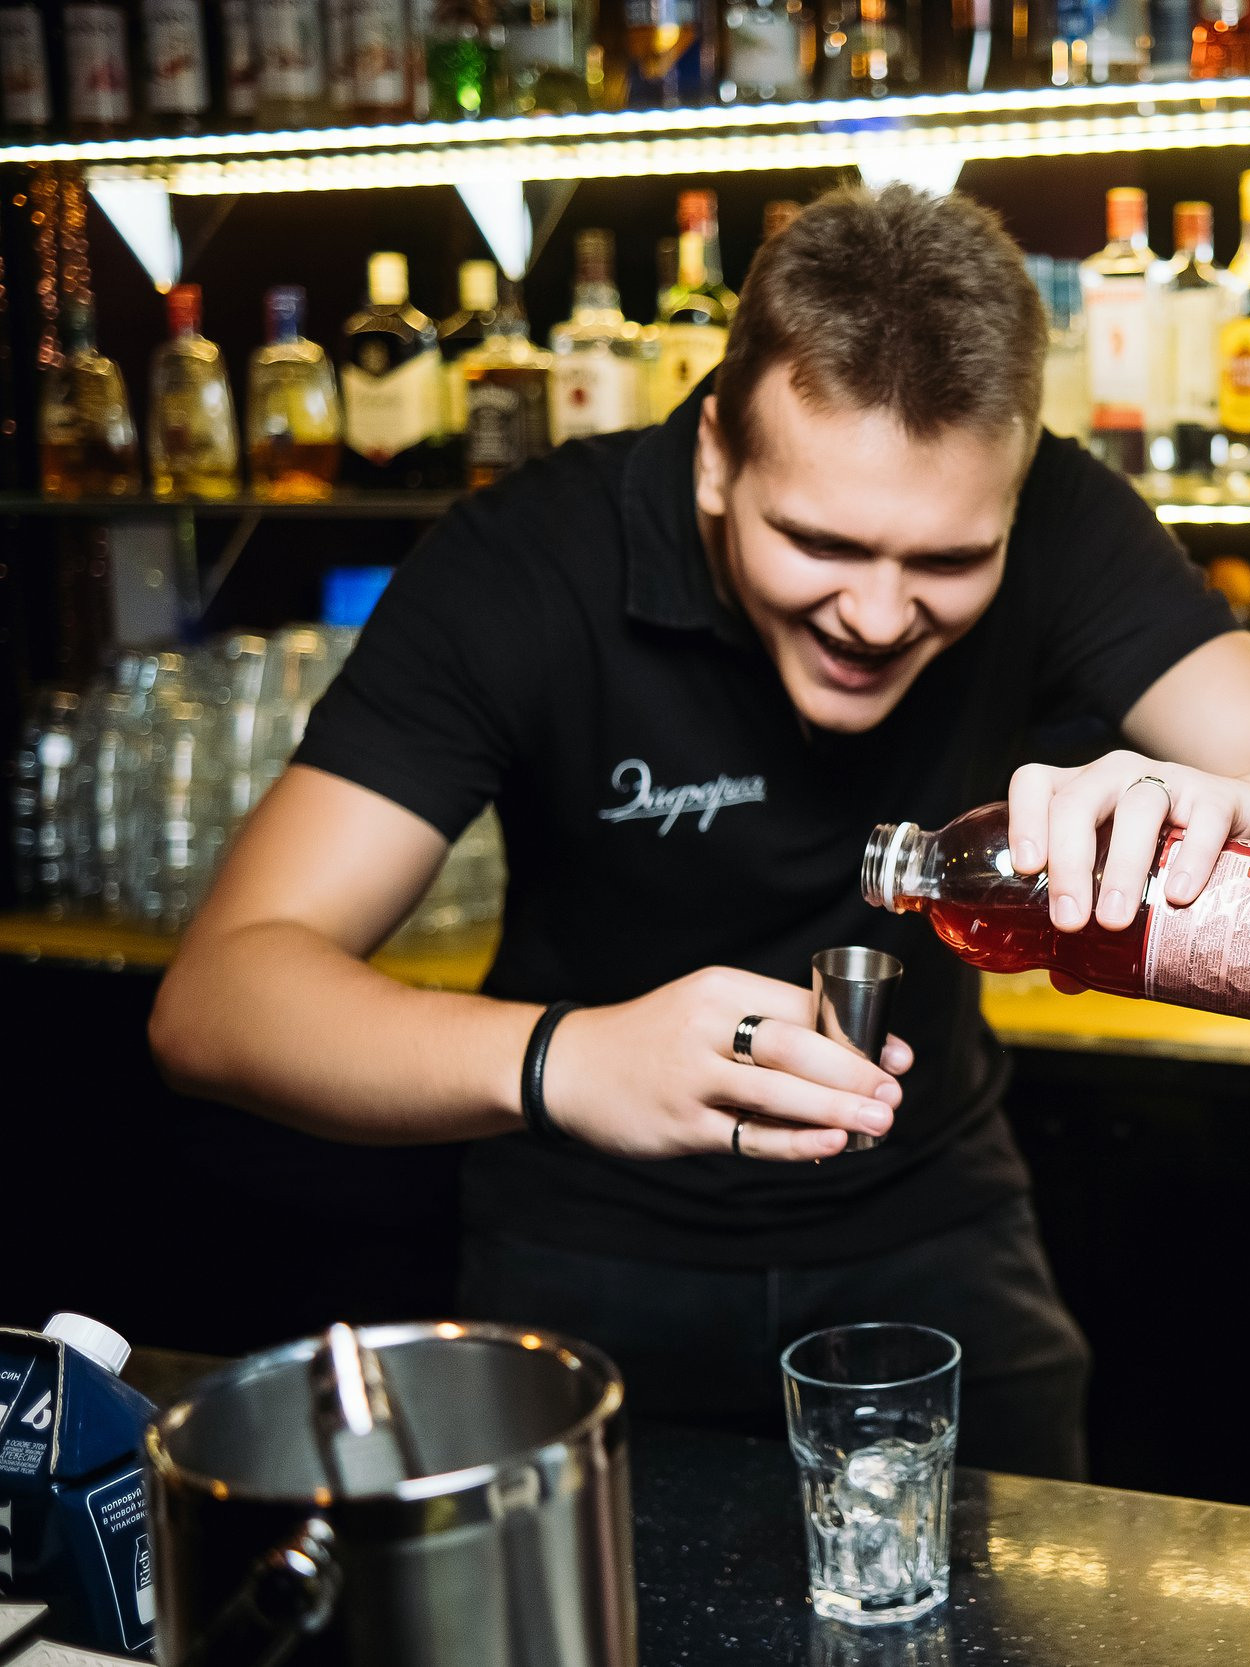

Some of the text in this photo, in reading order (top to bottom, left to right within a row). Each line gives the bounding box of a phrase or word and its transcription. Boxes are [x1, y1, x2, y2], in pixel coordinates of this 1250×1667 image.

[0, 1371, 21, 1381] СИН
[101, 1487, 142, 1514] ПОПРОБУЙ
[103, 1517, 109, 1526] В
[110, 1503, 137, 1522] НОВОЙ
[139, 1550, 151, 1588] Rich
